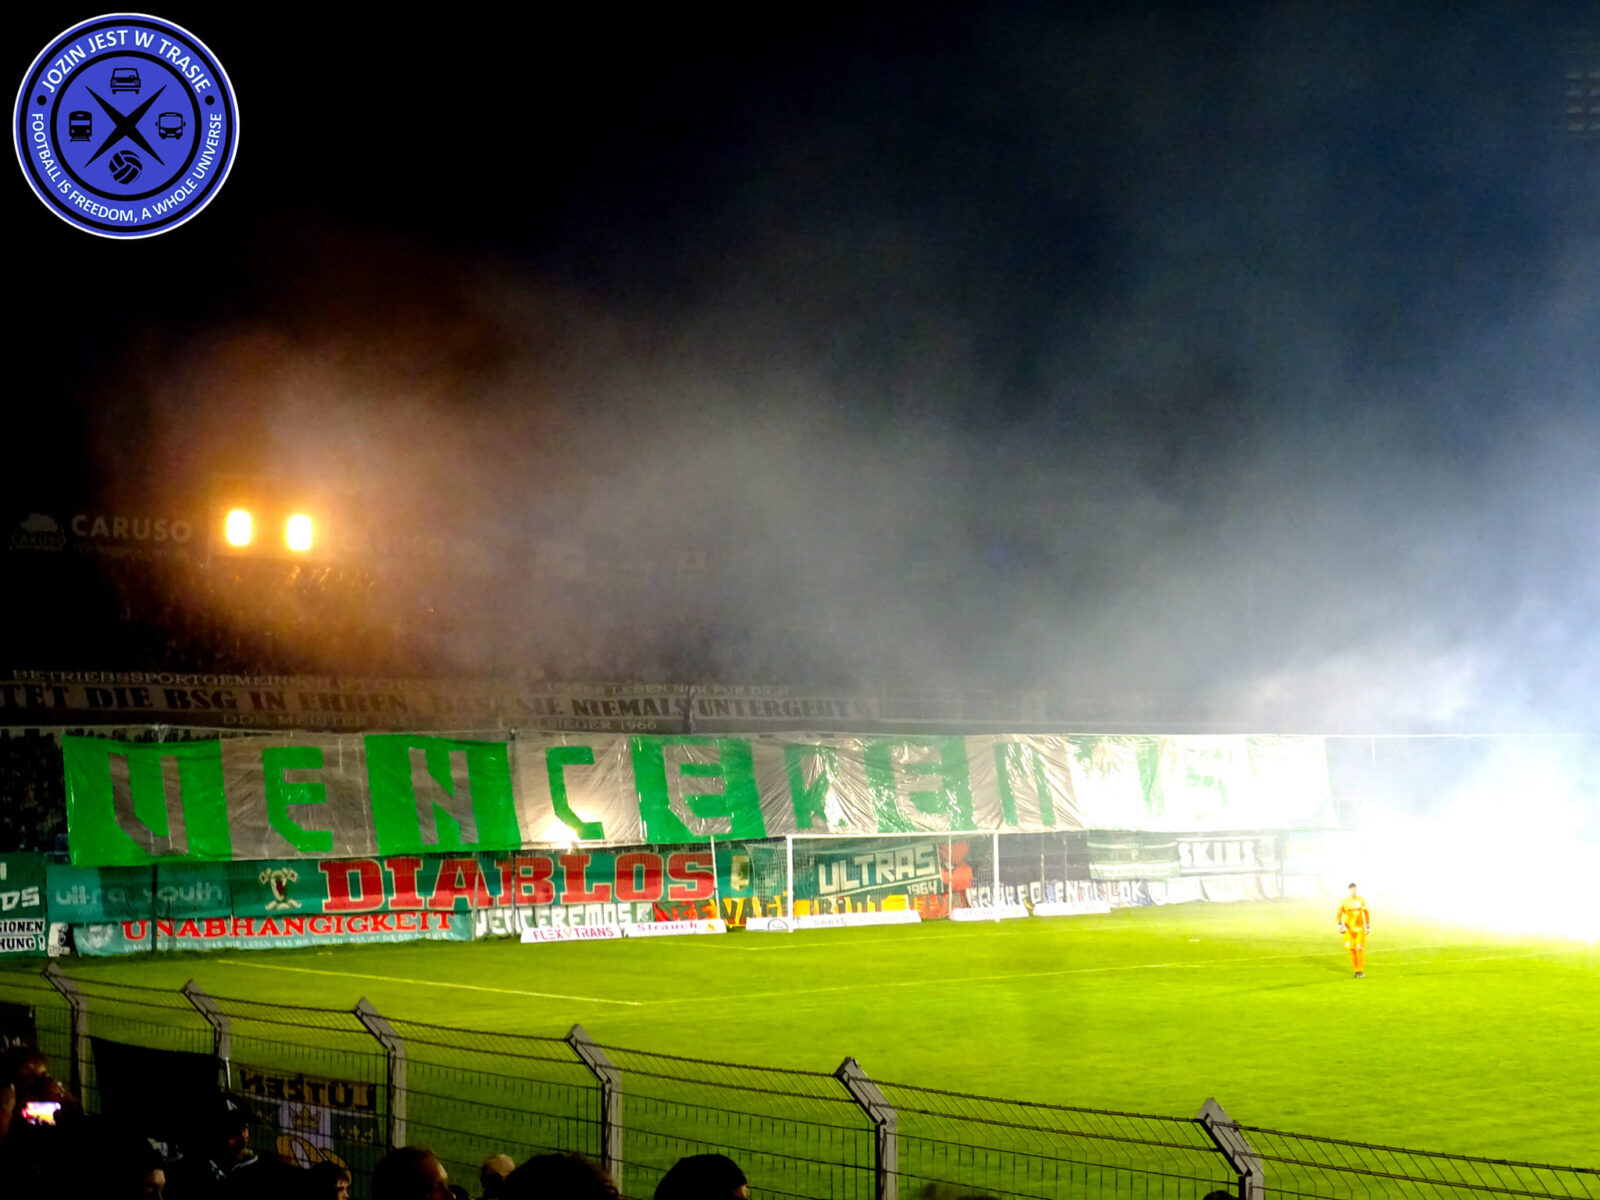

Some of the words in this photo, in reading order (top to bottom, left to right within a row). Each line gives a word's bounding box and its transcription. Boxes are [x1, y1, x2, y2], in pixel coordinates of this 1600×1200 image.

[71, 513, 193, 543] CARUSO
[83, 686, 153, 709] DIE
[163, 688, 237, 710] BSG
[249, 690, 287, 712] IN
[619, 719, 657, 732] 1966
[107, 742, 1230, 857] VENCEREMS
[318, 852, 715, 914] DIABLOS
[818, 844, 936, 894] ULTRAS
[907, 880, 938, 894] 1964
[636, 921, 699, 933] Strauch
